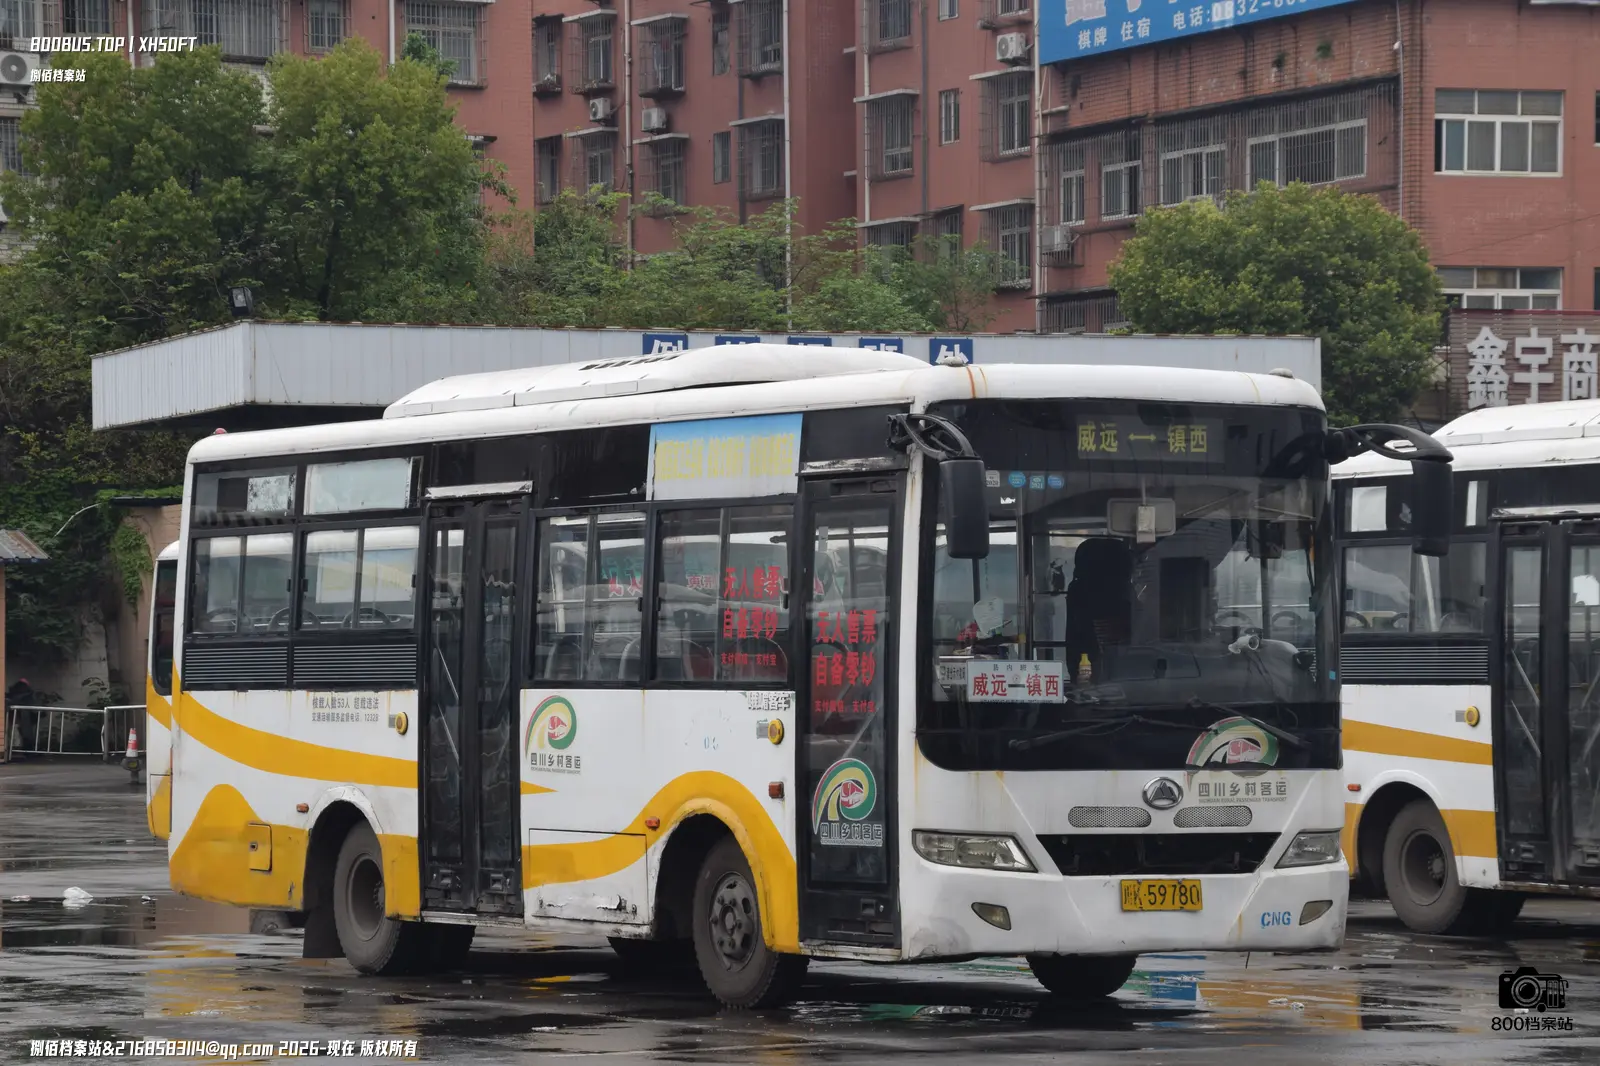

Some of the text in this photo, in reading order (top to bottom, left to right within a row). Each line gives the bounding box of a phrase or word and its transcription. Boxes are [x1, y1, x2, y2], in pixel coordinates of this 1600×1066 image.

[1078, 27, 1107, 50] 棋牌
[1120, 17, 1151, 42] 住宿
[1466, 326, 1600, 409] 鑫宇商
[1077, 421, 1208, 453] 威远 镇西
[723, 566, 782, 599] 无人售票
[723, 607, 778, 639] 自备零钞
[815, 609, 877, 644] 无人售票
[815, 652, 876, 687] 自备零钞
[530, 752, 581, 769] 四川乡村客运
[1198, 781, 1287, 797] 四川乡村客运
[819, 822, 884, 840] 四川乡村客运
[1261, 911, 1291, 928] CNG
